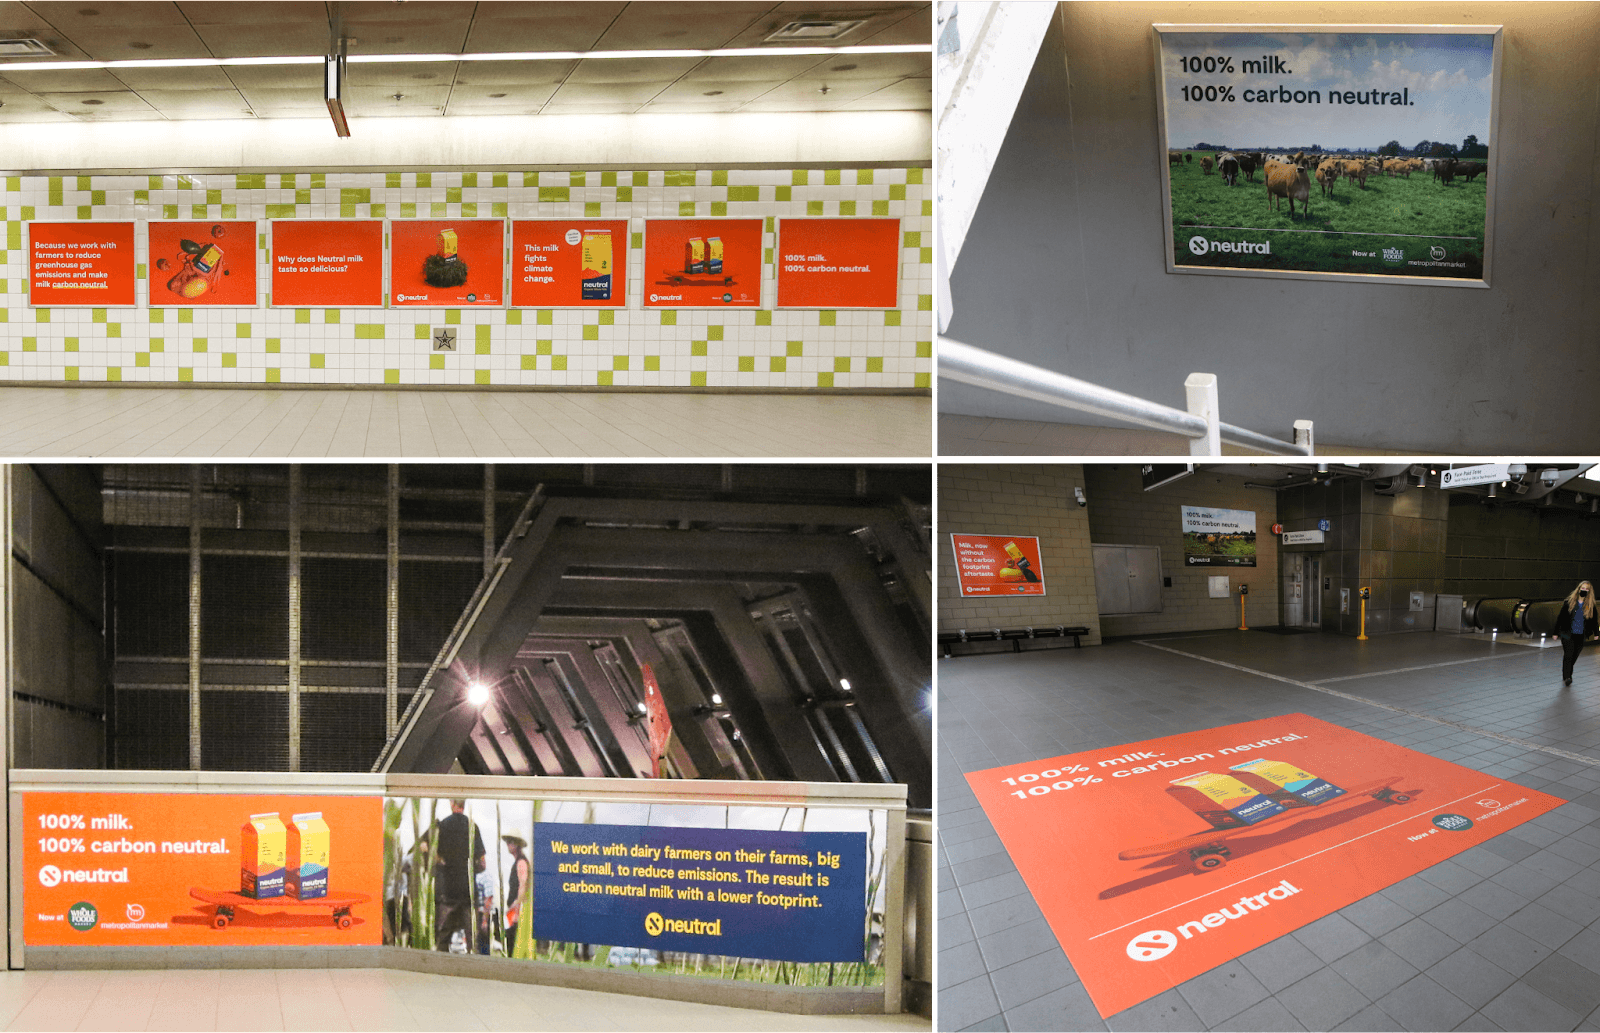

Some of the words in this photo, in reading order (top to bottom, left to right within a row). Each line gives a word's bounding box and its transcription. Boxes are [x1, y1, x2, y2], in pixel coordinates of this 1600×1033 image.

[1180, 57, 1234, 73] 100%
[1242, 55, 1292, 74] milk.
[1181, 86, 1235, 102] 100%
[1243, 86, 1321, 104] carbon
[1329, 88, 1414, 106] neutral.
[1211, 240, 1270, 254] neutral
[278, 255, 295, 264] Why
[524, 254, 547, 263] fights
[1408, 260, 1466, 268] metropolitanmarket
[524, 275, 555, 284] change.
[1001, 764, 1089, 786] 100%
[1098, 751, 1165, 768] milk.
[1010, 775, 1103, 800] 100%
[1111, 752, 1215, 778] carbon
[1218, 733, 1308, 755] neutral.
[1301, 783, 1332, 797] neutral
[1237, 800, 1272, 816] neutral
[39, 814, 85, 829] 100%
[91, 814, 133, 829] milk.
[1407, 832, 1428, 842] Now
[39, 838, 85, 853] 100%
[91, 837, 155, 853] carbon
[161, 838, 230, 853] neutral.
[551, 841, 569, 854] We
[572, 842, 600, 855] work
[603, 843, 628, 856] with
[631, 845, 661, 862] dairy
[664, 846, 712, 860] farmers
[715, 851, 732, 862] on
[735, 849, 766, 863] their
[769, 850, 813, 867] farms,
[817, 851, 840, 869] big
[63, 867, 128, 882] neutral
[558, 861, 579, 873] and
[582, 862, 614, 877] small,
[618, 864, 630, 876] to
[633, 865, 674, 878] reduce
[678, 867, 742, 883] emissions.
[745, 869, 770, 884] The
[773, 872, 813, 887] result
[817, 872, 830, 887] is
[562, 880, 602, 894] carbon
[605, 884, 646, 897] neutral
[649, 885, 674, 899] milk
[677, 887, 704, 901] with
[707, 892, 715, 902] a
[718, 888, 753, 904] lower
[757, 891, 822, 910] footprint.
[71, 908, 95, 917] WHOLE
[1176, 880, 1300, 940] neutral
[101, 922, 168, 930] metropolitanmarket
[665, 918, 721, 936] neutral
